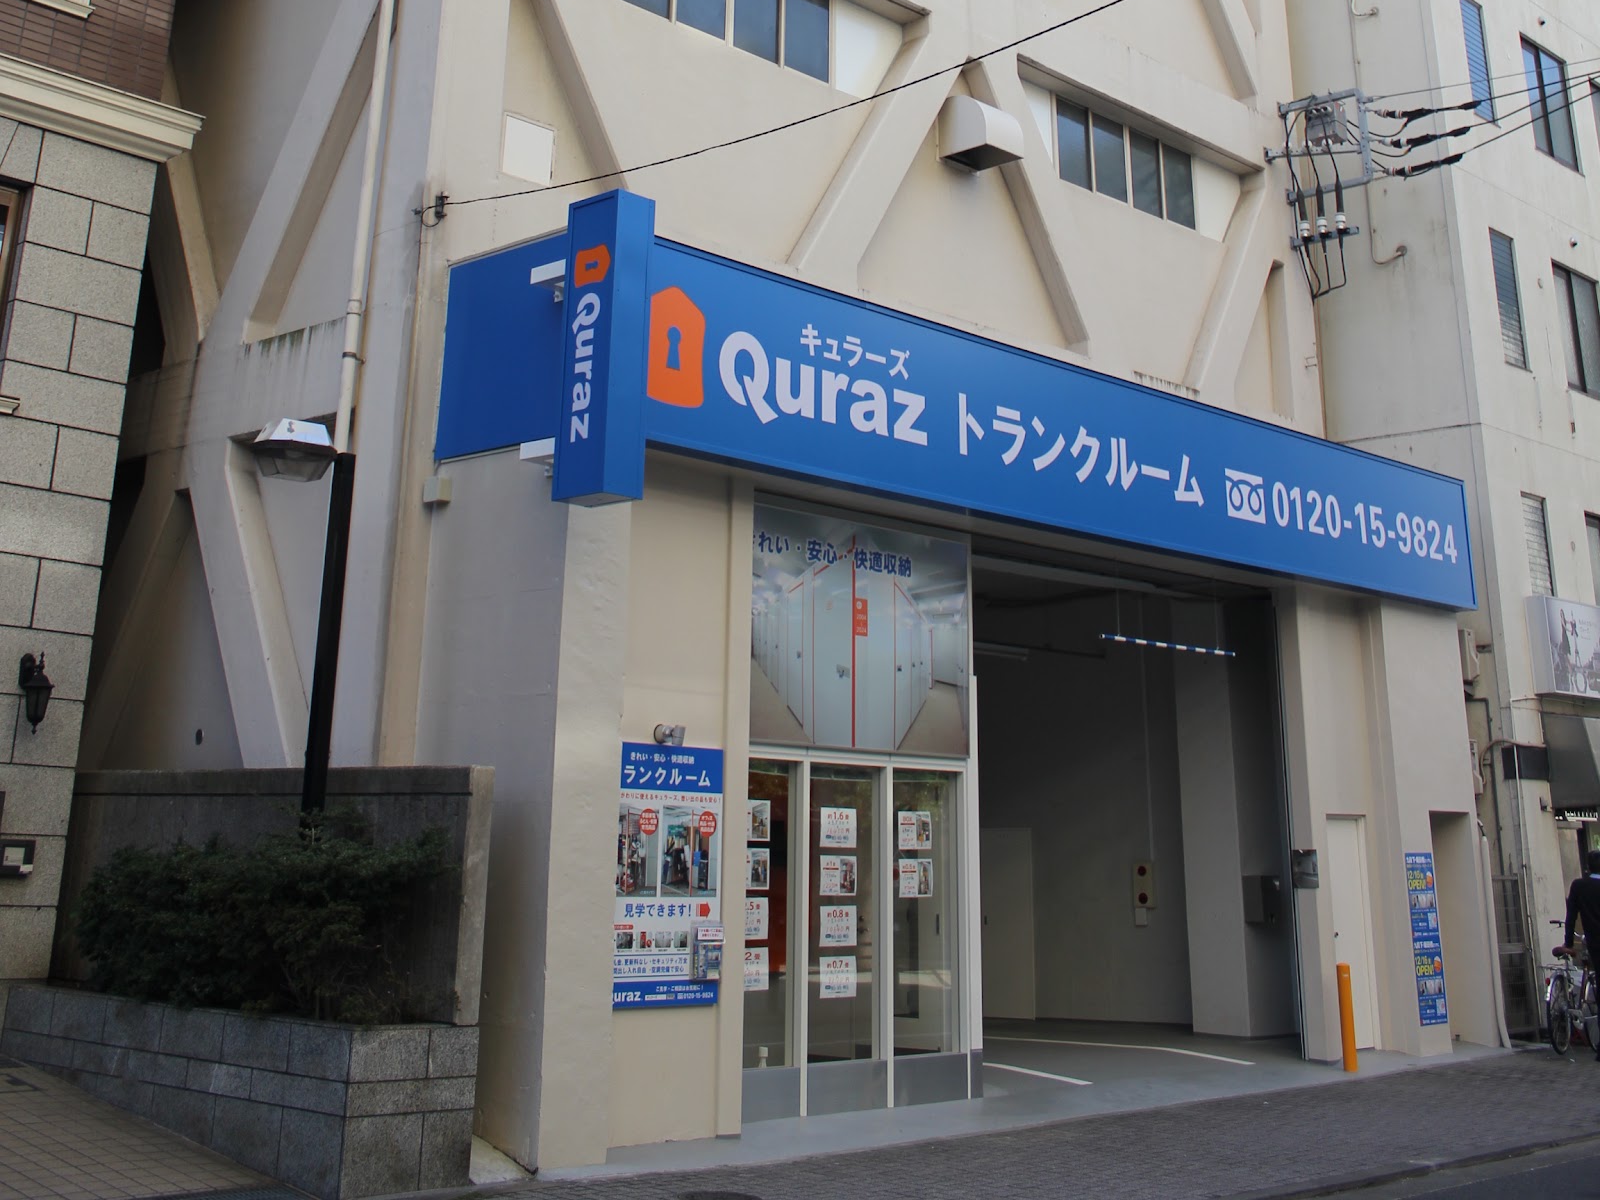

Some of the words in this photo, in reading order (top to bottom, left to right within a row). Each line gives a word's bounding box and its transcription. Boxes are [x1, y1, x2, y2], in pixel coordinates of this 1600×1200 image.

[569, 292, 601, 444] Quraz
[718, 330, 928, 446] Quraz
[800, 323, 910, 380] キュラーズ
[957, 392, 1206, 507] トランクルーム
[753, 531, 912, 578] れい・安心・快適収納
[1271, 480, 1458, 565] 0120-15-9824
[612, 991, 642, 1003] uraz
